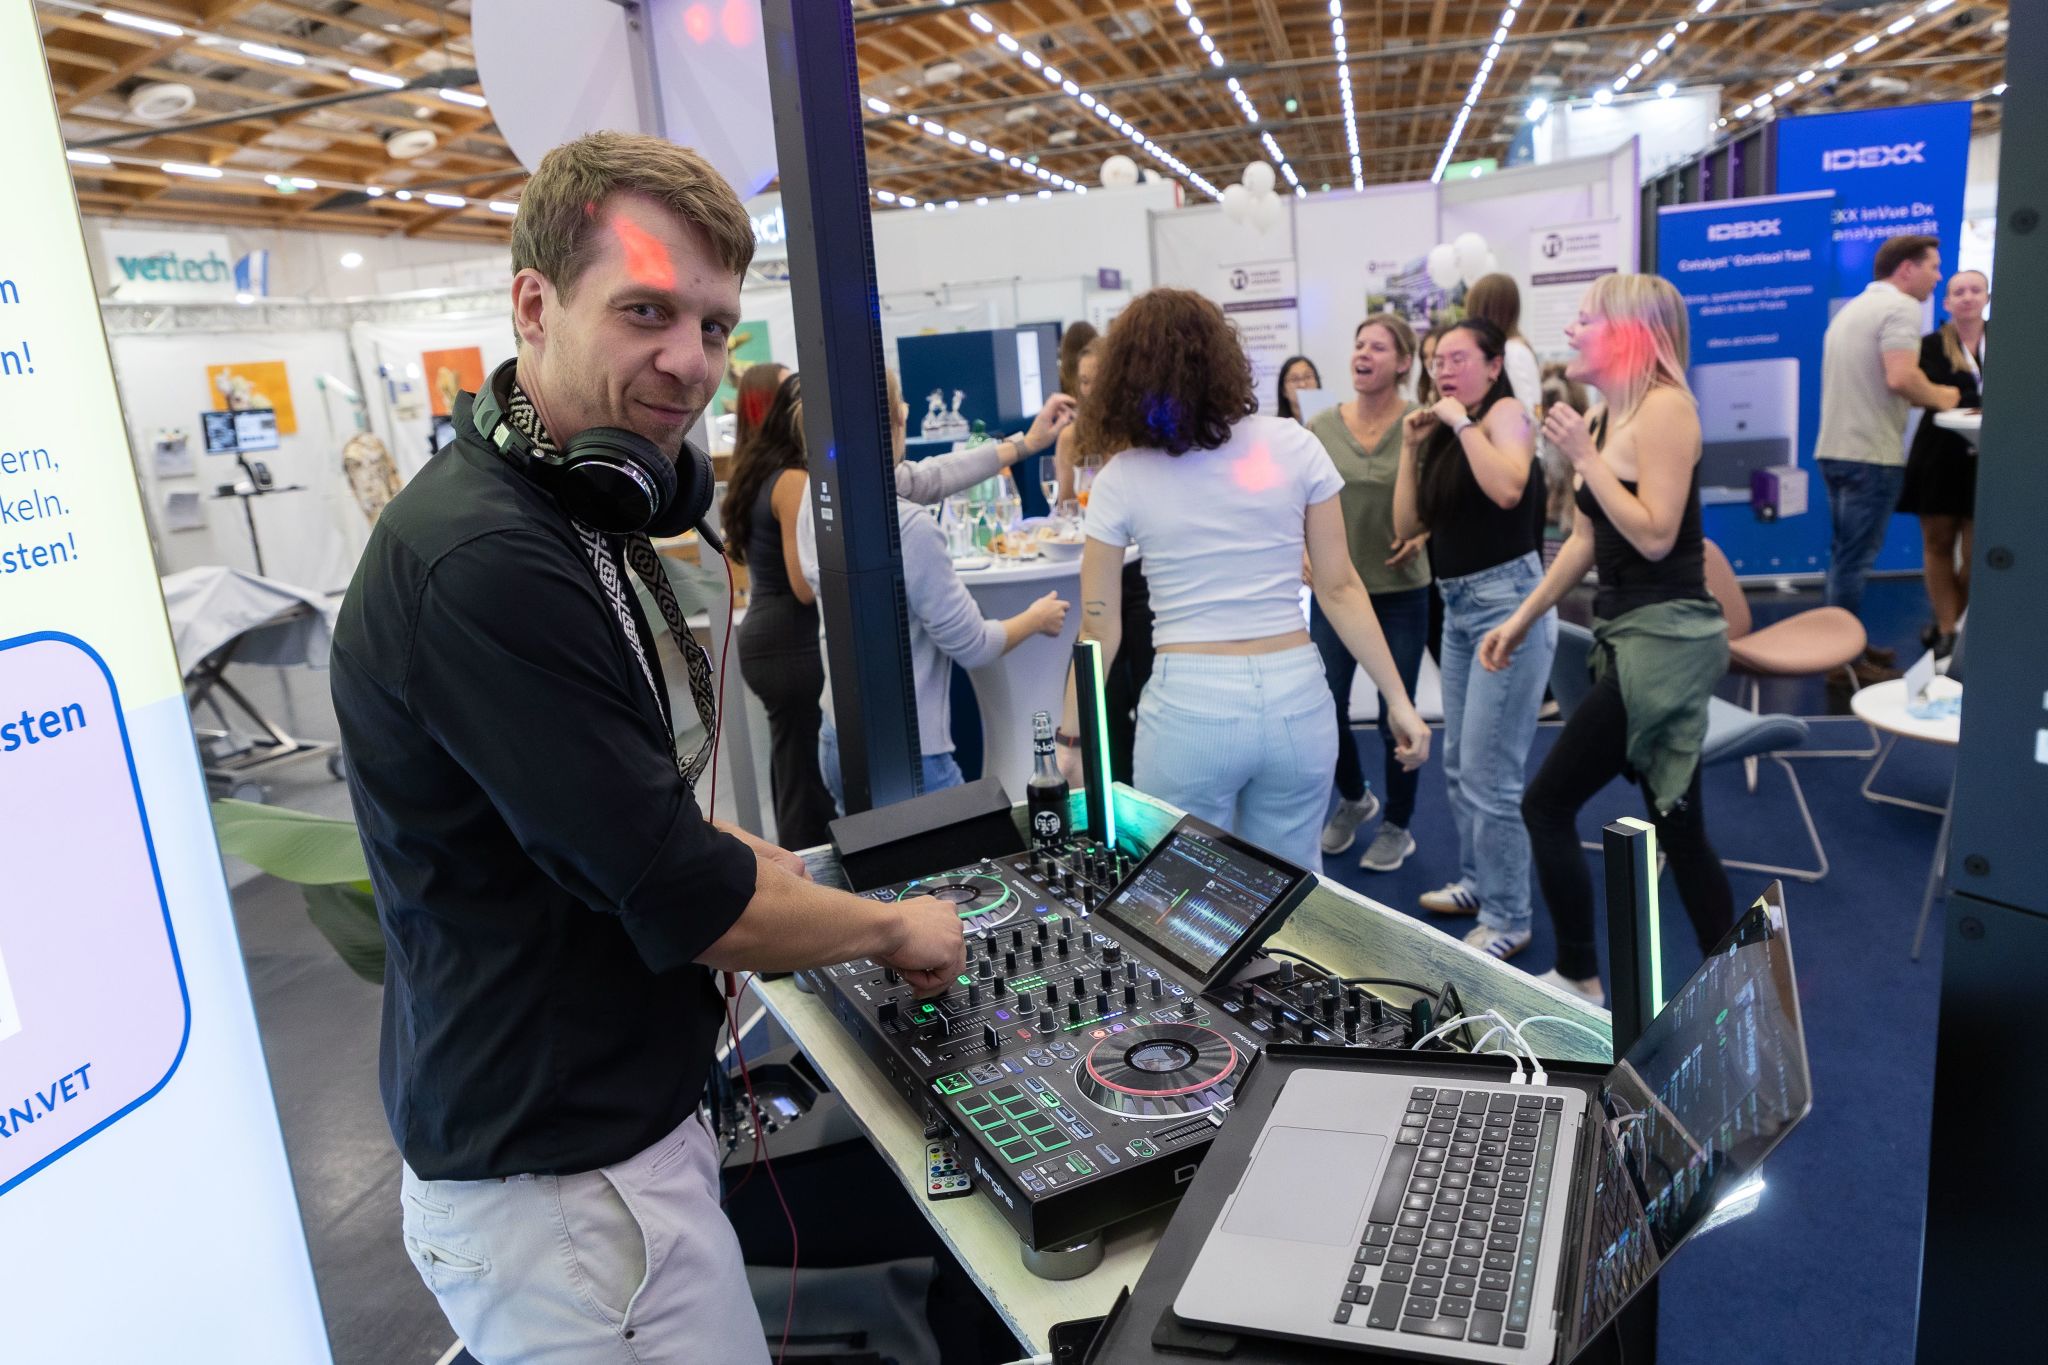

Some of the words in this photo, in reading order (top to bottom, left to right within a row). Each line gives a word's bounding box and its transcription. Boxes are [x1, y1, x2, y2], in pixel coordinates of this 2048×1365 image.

[1822, 141, 1926, 172] IDEXX
[1707, 218, 1782, 242] IDEXX
[117, 251, 232, 283] vettech
[0, 489, 69, 524] keln.
[0, 532, 77, 573] sten!
[0, 702, 87, 751] sten
